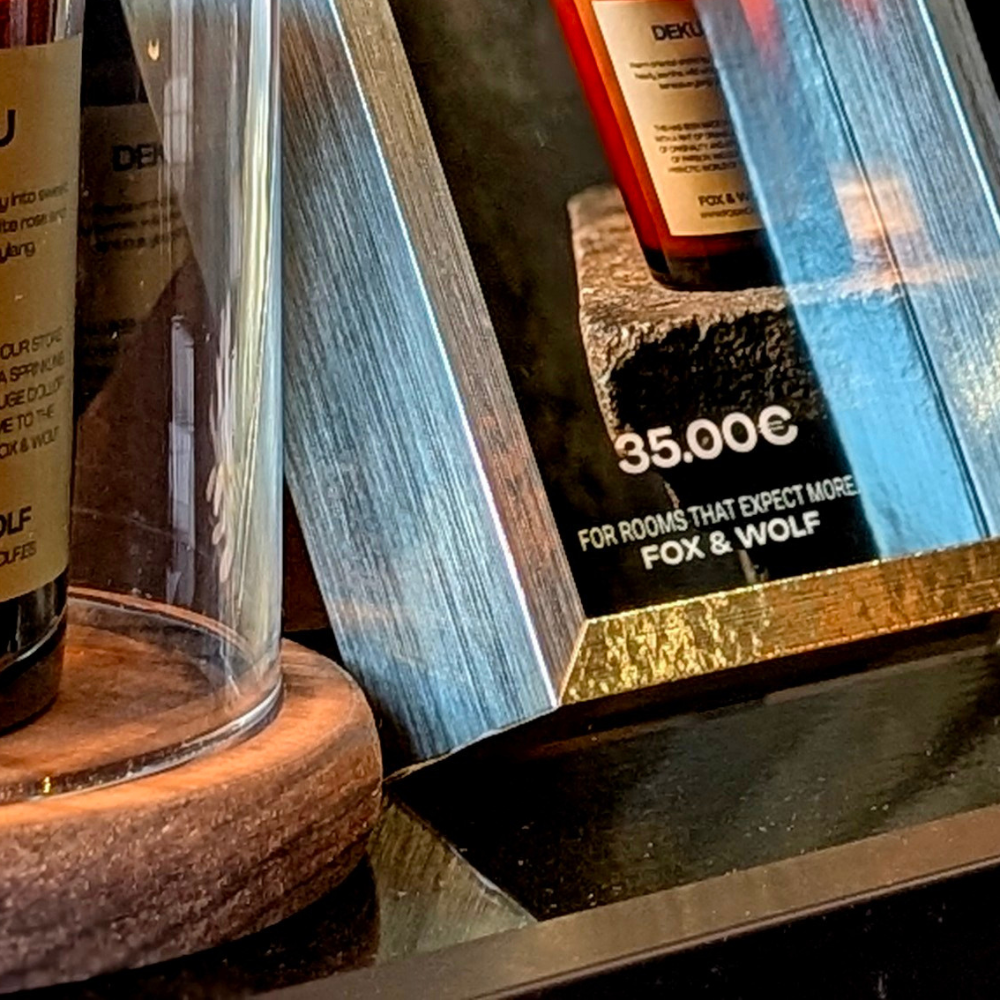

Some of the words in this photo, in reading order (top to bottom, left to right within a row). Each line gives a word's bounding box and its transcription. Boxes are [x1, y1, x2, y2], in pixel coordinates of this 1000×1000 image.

[651, 21, 705, 41] DEKU
[0, 338, 30, 360] OUR
[16, 412, 34, 431] TO
[613, 404, 799, 474] 35.00€
[578, 524, 618, 552] FOR
[618, 508, 689, 544] ROOMS
[687, 497, 736, 528] THAT
[738, 483, 805, 519] EXPECT
[640, 534, 706, 570] FOX
[709, 530, 734, 556] &
[734, 510, 822, 548] WOLF
